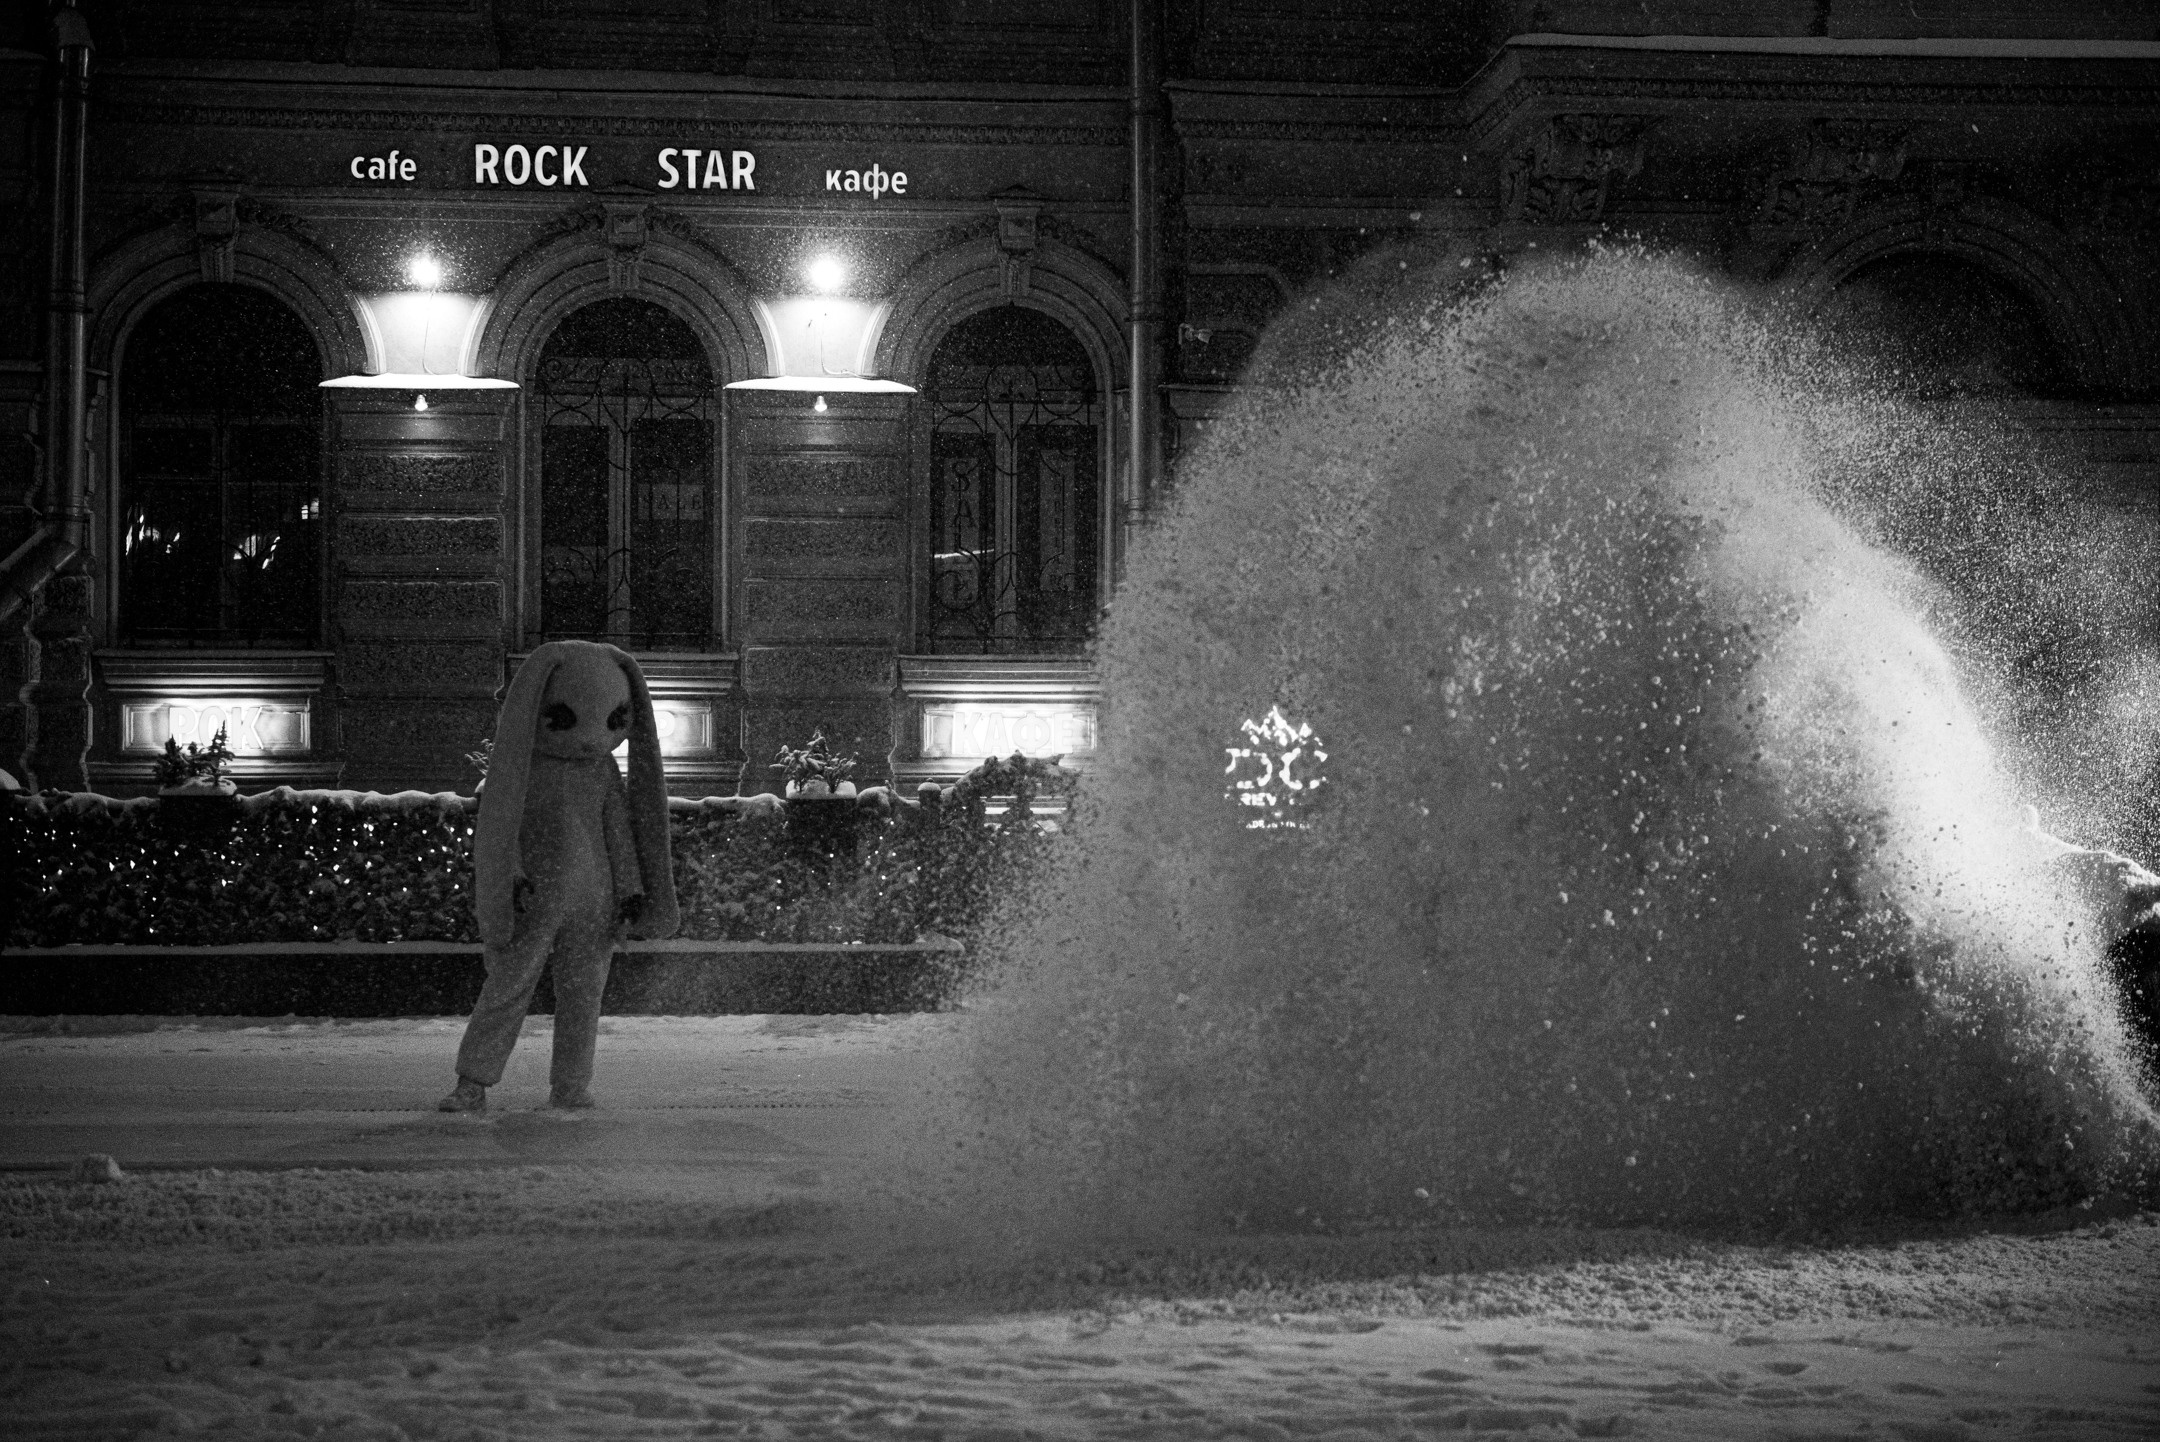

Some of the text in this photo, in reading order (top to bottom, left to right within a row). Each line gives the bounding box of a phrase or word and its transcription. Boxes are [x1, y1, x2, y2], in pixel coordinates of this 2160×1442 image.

[351, 144, 755, 189] cafe ROCK STAR
[826, 164, 907, 199] кафе
[954, 711, 1074, 754] КАФЕ
